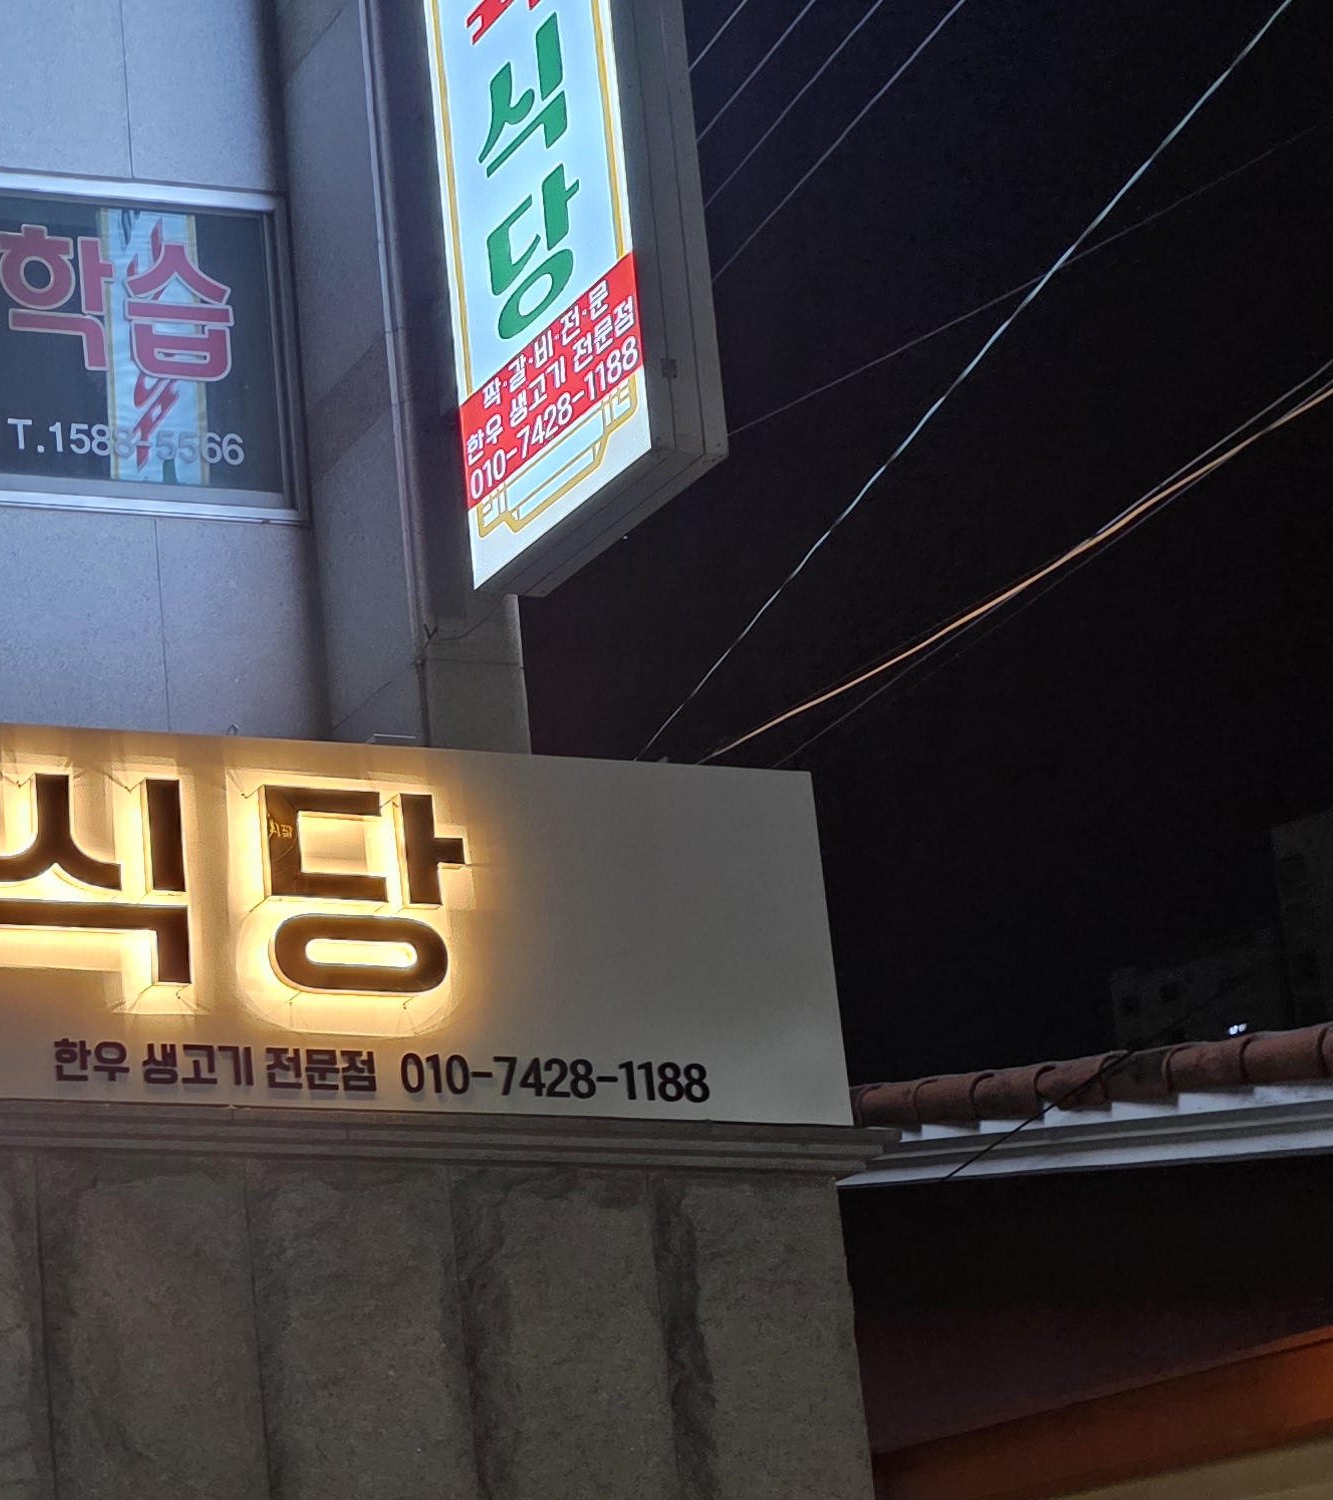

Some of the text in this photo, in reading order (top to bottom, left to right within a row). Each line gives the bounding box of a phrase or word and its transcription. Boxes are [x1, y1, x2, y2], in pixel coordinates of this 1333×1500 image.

[465, 0, 580, 340] 식당
[466, 295, 635, 466] 한우 생고기 전문점
[469, 336, 638, 500] 010-7428-1188
[53, 1038, 711, 1104] 한우 생고기 전문점 010-7428-1188
